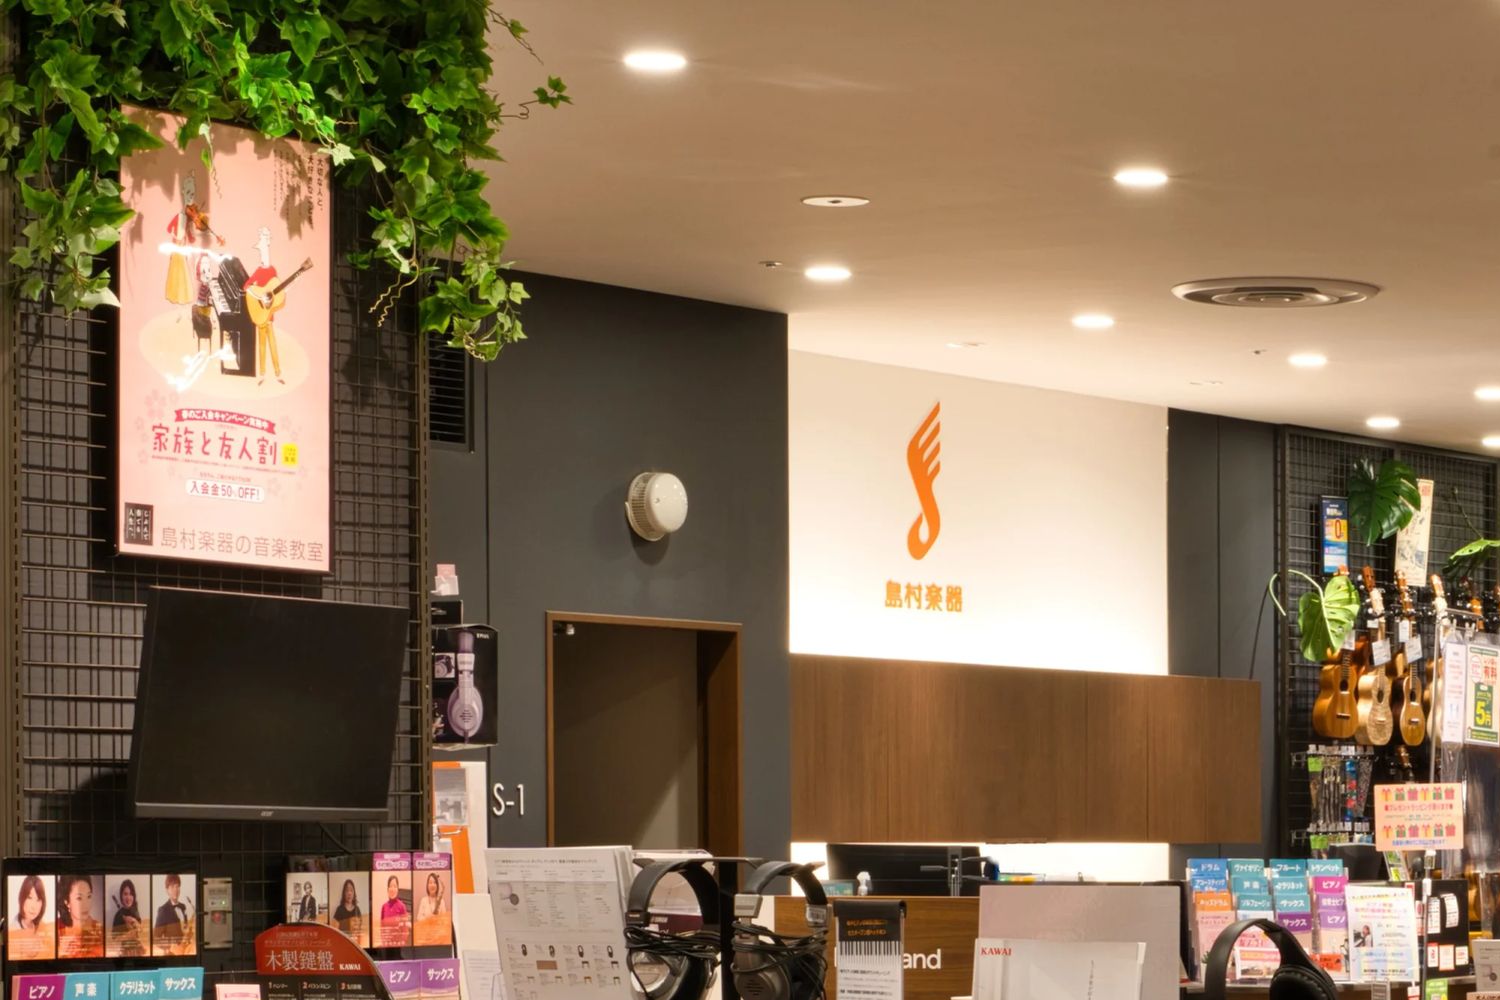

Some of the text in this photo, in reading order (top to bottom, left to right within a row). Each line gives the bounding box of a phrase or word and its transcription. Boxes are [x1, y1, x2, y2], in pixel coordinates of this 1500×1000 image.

[151, 422, 278, 466] 家族と友人割
[160, 526, 325, 563] 島村楽器の音楽教室
[884, 580, 963, 613] 島村楽器
[492, 783, 525, 817] S-1
[1201, 863, 1220, 872] ドラム
[1277, 863, 1301, 872] フルート
[1322, 881, 1340, 889] ピアノ
[1280, 899, 1305, 908] サックス
[1282, 918, 1307, 927] サックス
[1327, 915, 1345, 925] ピアノ
[980, 947, 1013, 956] KAWAI
[265, 949, 362, 972] 木製鍵盤 KAWAI
[389, 969, 411, 984] ピアノ
[426, 967, 455, 981] サックス
[75, 982, 98, 998] 声楽
[119, 981, 156, 996] クラリネット
[164, 977, 197, 992] サックス
[28, 985, 56, 1000] ピアノ
